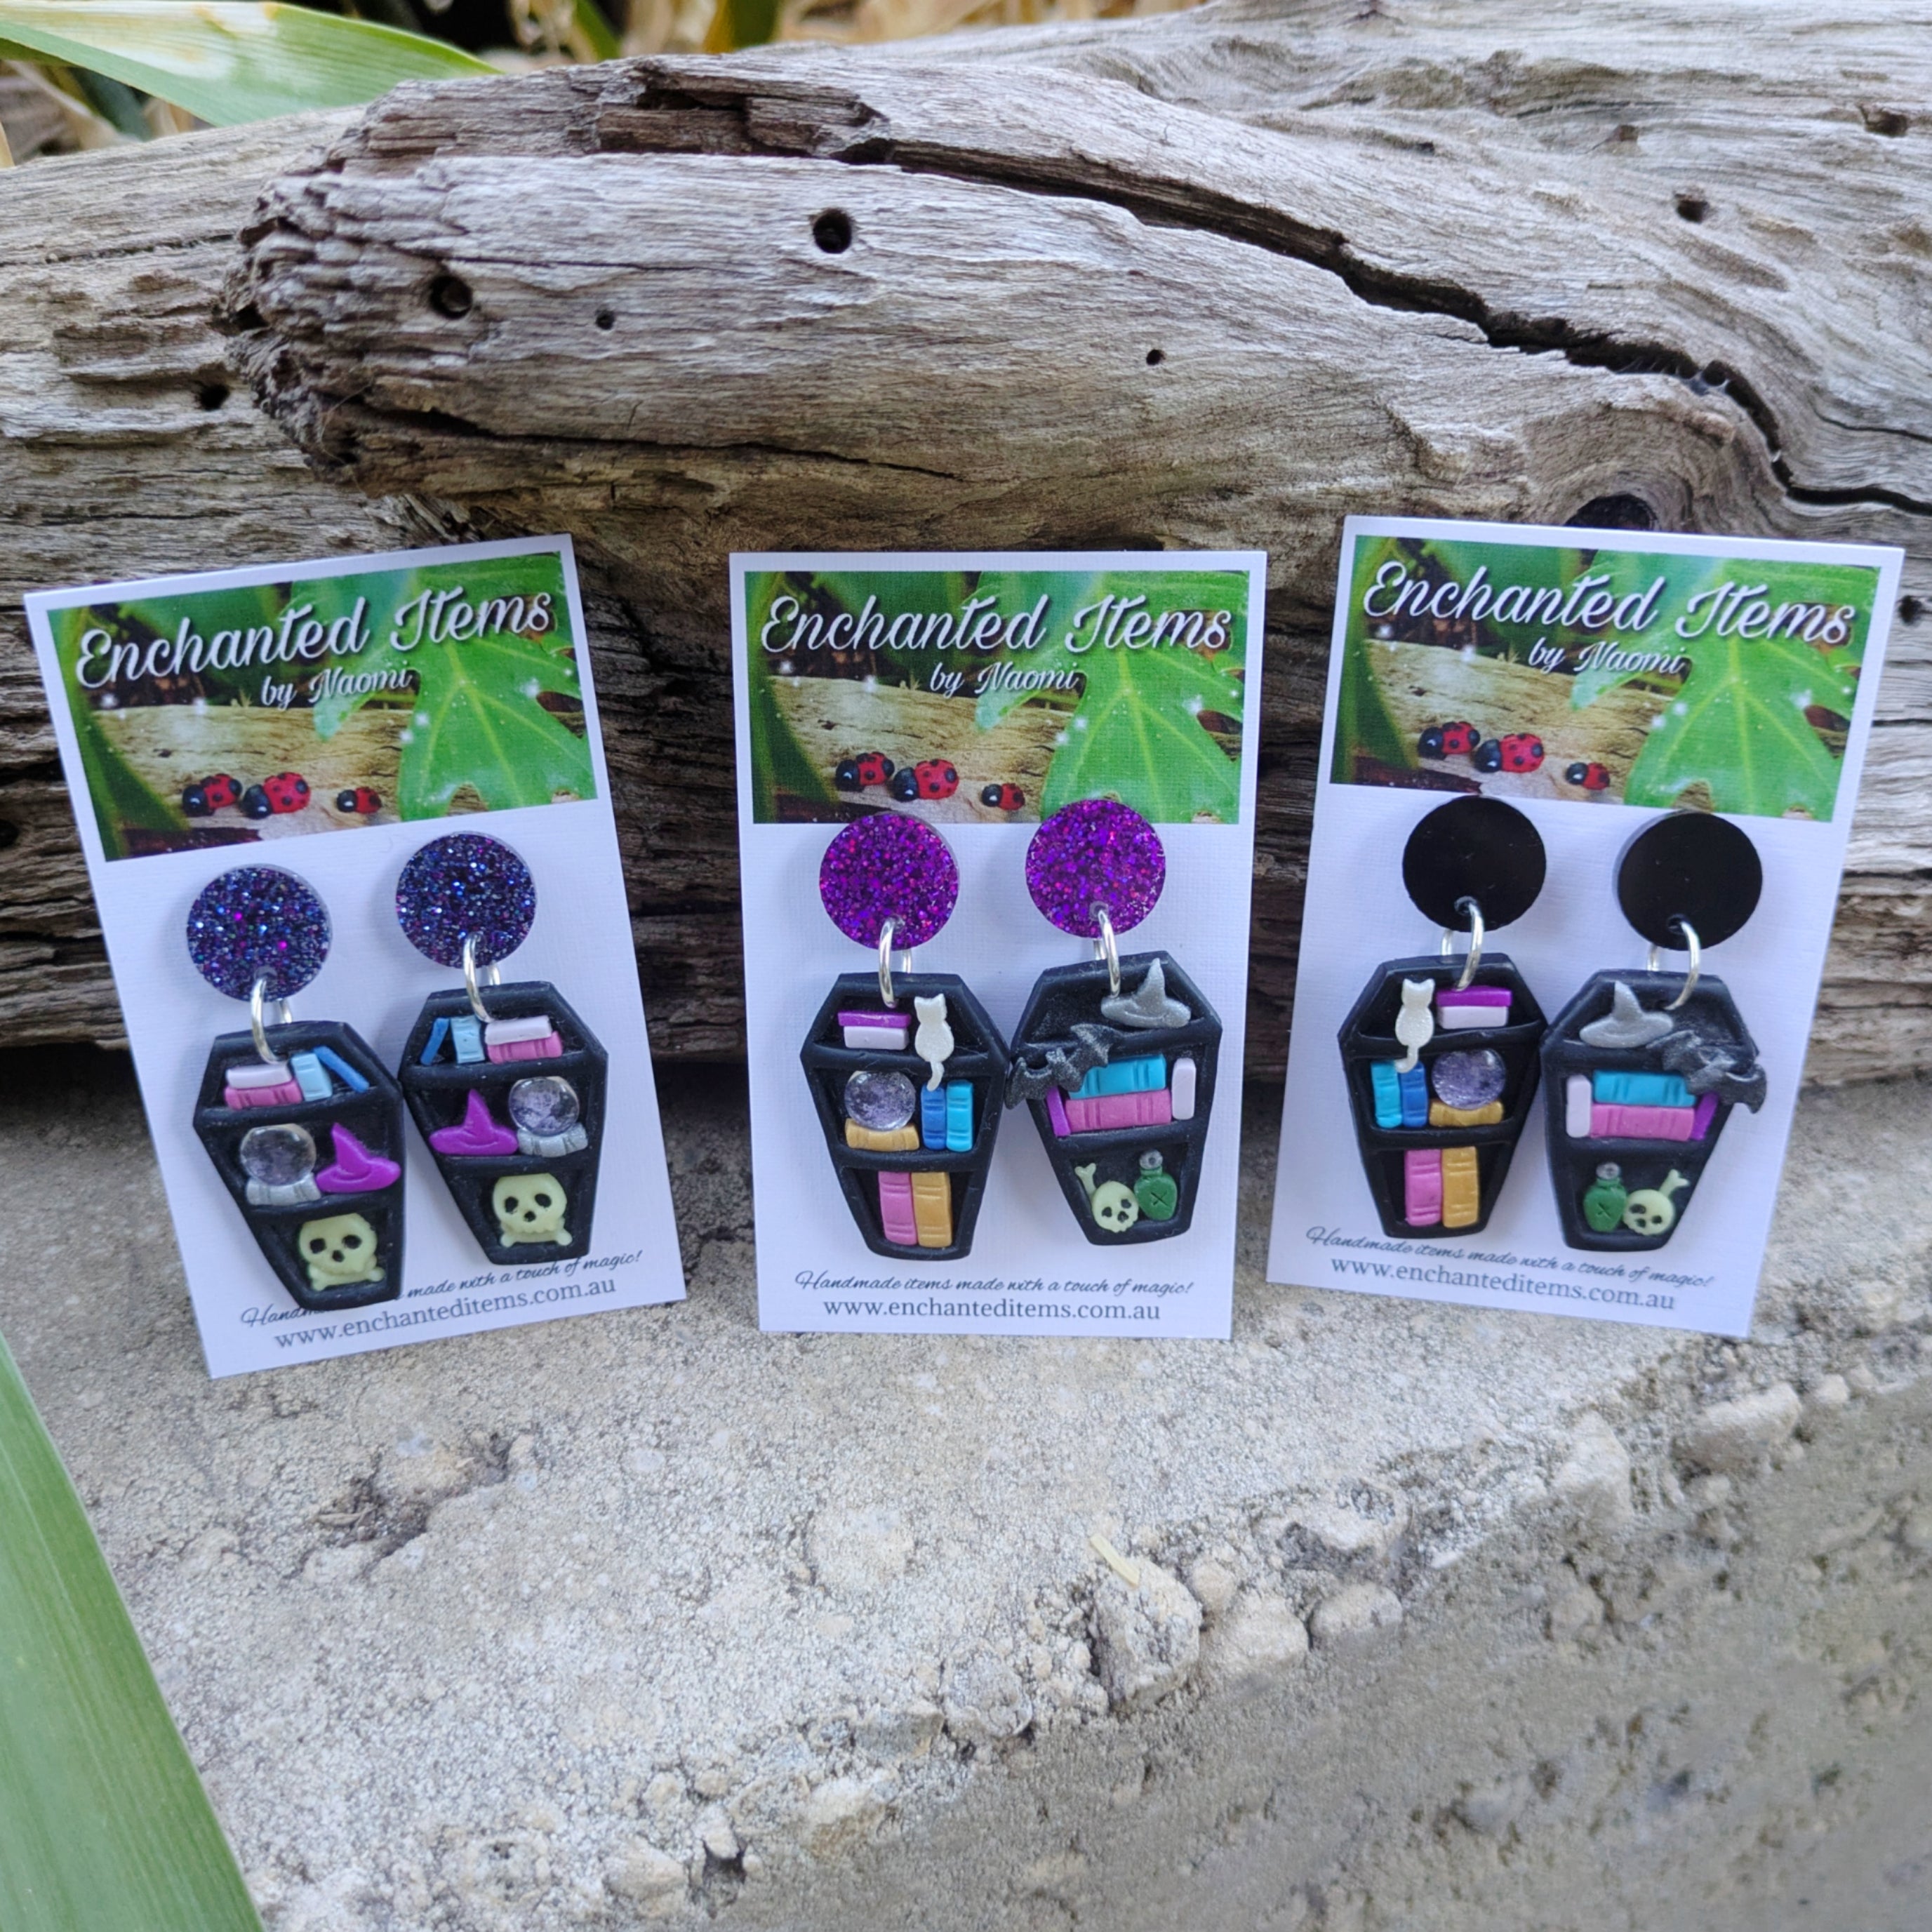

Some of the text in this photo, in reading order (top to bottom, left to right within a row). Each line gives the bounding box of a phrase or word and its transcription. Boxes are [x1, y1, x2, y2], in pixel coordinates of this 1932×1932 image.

[761, 594, 1232, 653] Enchanted Items
[1363, 561, 1857, 646] Enchanted Items
[76, 585, 553, 690] Enchanted Items
[1528, 637, 1687, 675] by Naomi
[261, 666, 413, 711] by Naomi
[930, 661, 1079, 698] by Naomi
[407, 1279, 456, 1298] made
[460, 1271, 497, 1290] with
[500, 1272, 514, 1284] a
[516, 1261, 561, 1281] touch
[564, 1255, 583, 1277] of
[582, 1250, 643, 1270] magic!
[1305, 1226, 1715, 1288] Handmade items made with a touch of magic!
[795, 1270, 1194, 1298] Handmade items made with a touch of magic!
[823, 1297, 1161, 1320] www.enchanteditems.com.au
[1330, 1258, 1675, 1310] www.enchanteditems.com.au
[274, 1278, 617, 1348] www.enchanteditems.com.au
